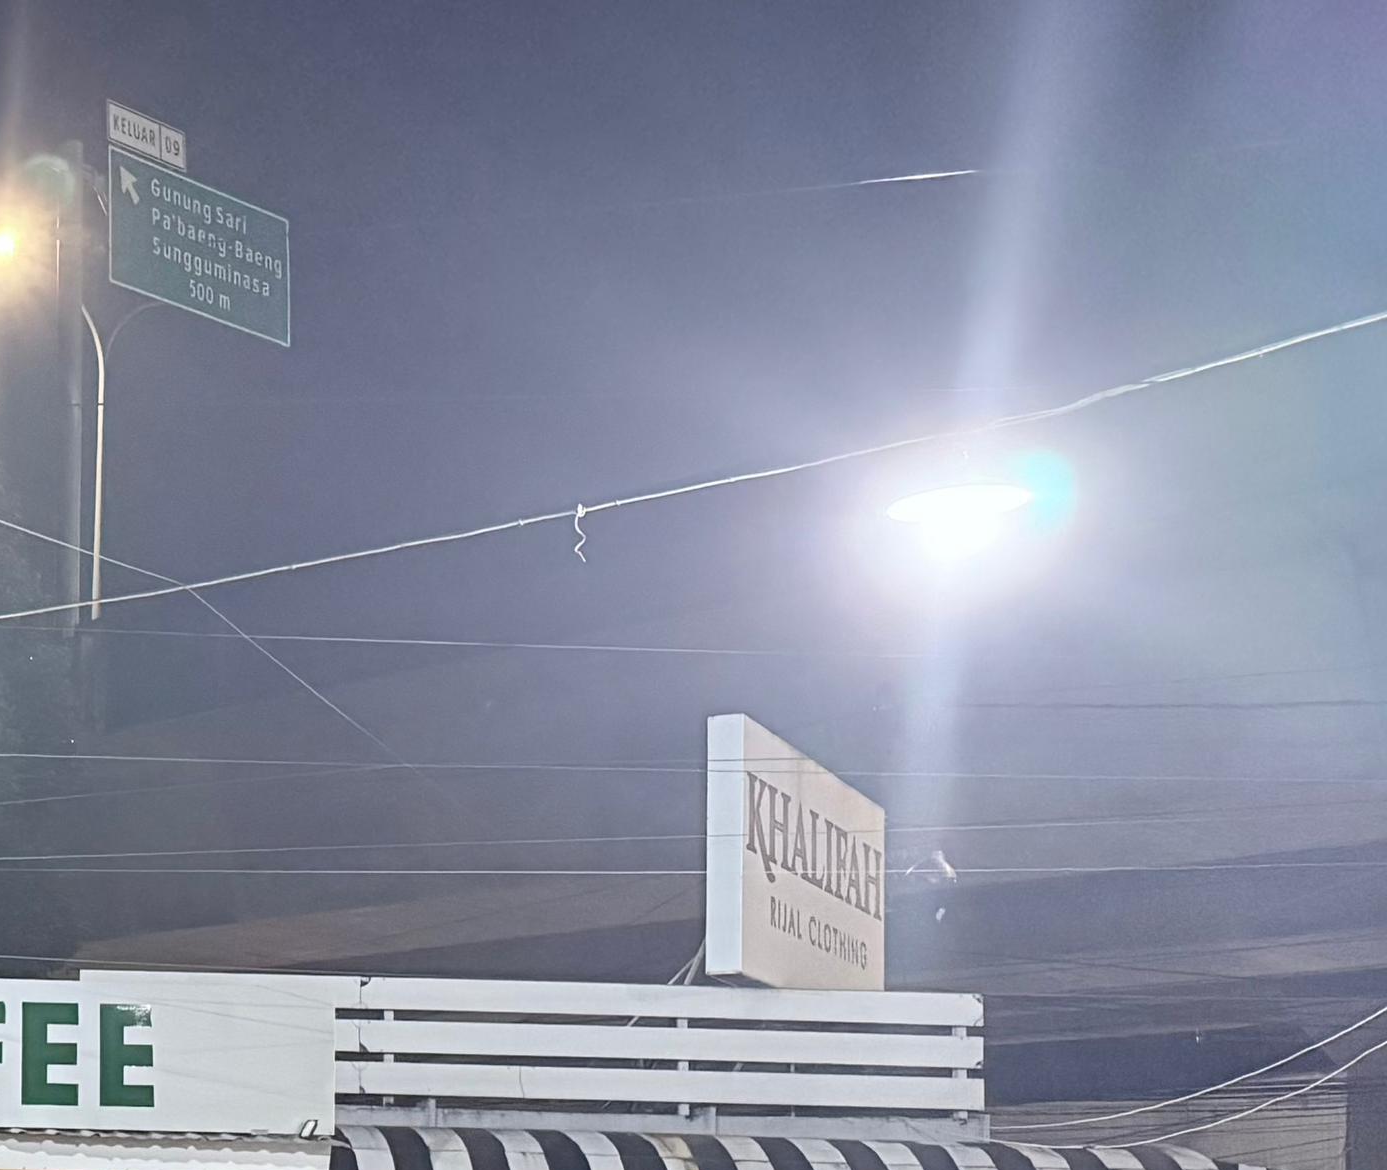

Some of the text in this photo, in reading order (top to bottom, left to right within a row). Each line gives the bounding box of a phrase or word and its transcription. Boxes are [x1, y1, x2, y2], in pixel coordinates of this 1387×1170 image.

[113, 114, 181, 156] KELUAR 09
[151, 179, 247, 235] Gunung Sari
[153, 237, 270, 297] Sungguminasa
[189, 279, 231, 311] 500 m
[746, 771, 882, 922] KHALIFAH
[770, 896, 868, 970] RIJAL CLOTHING
